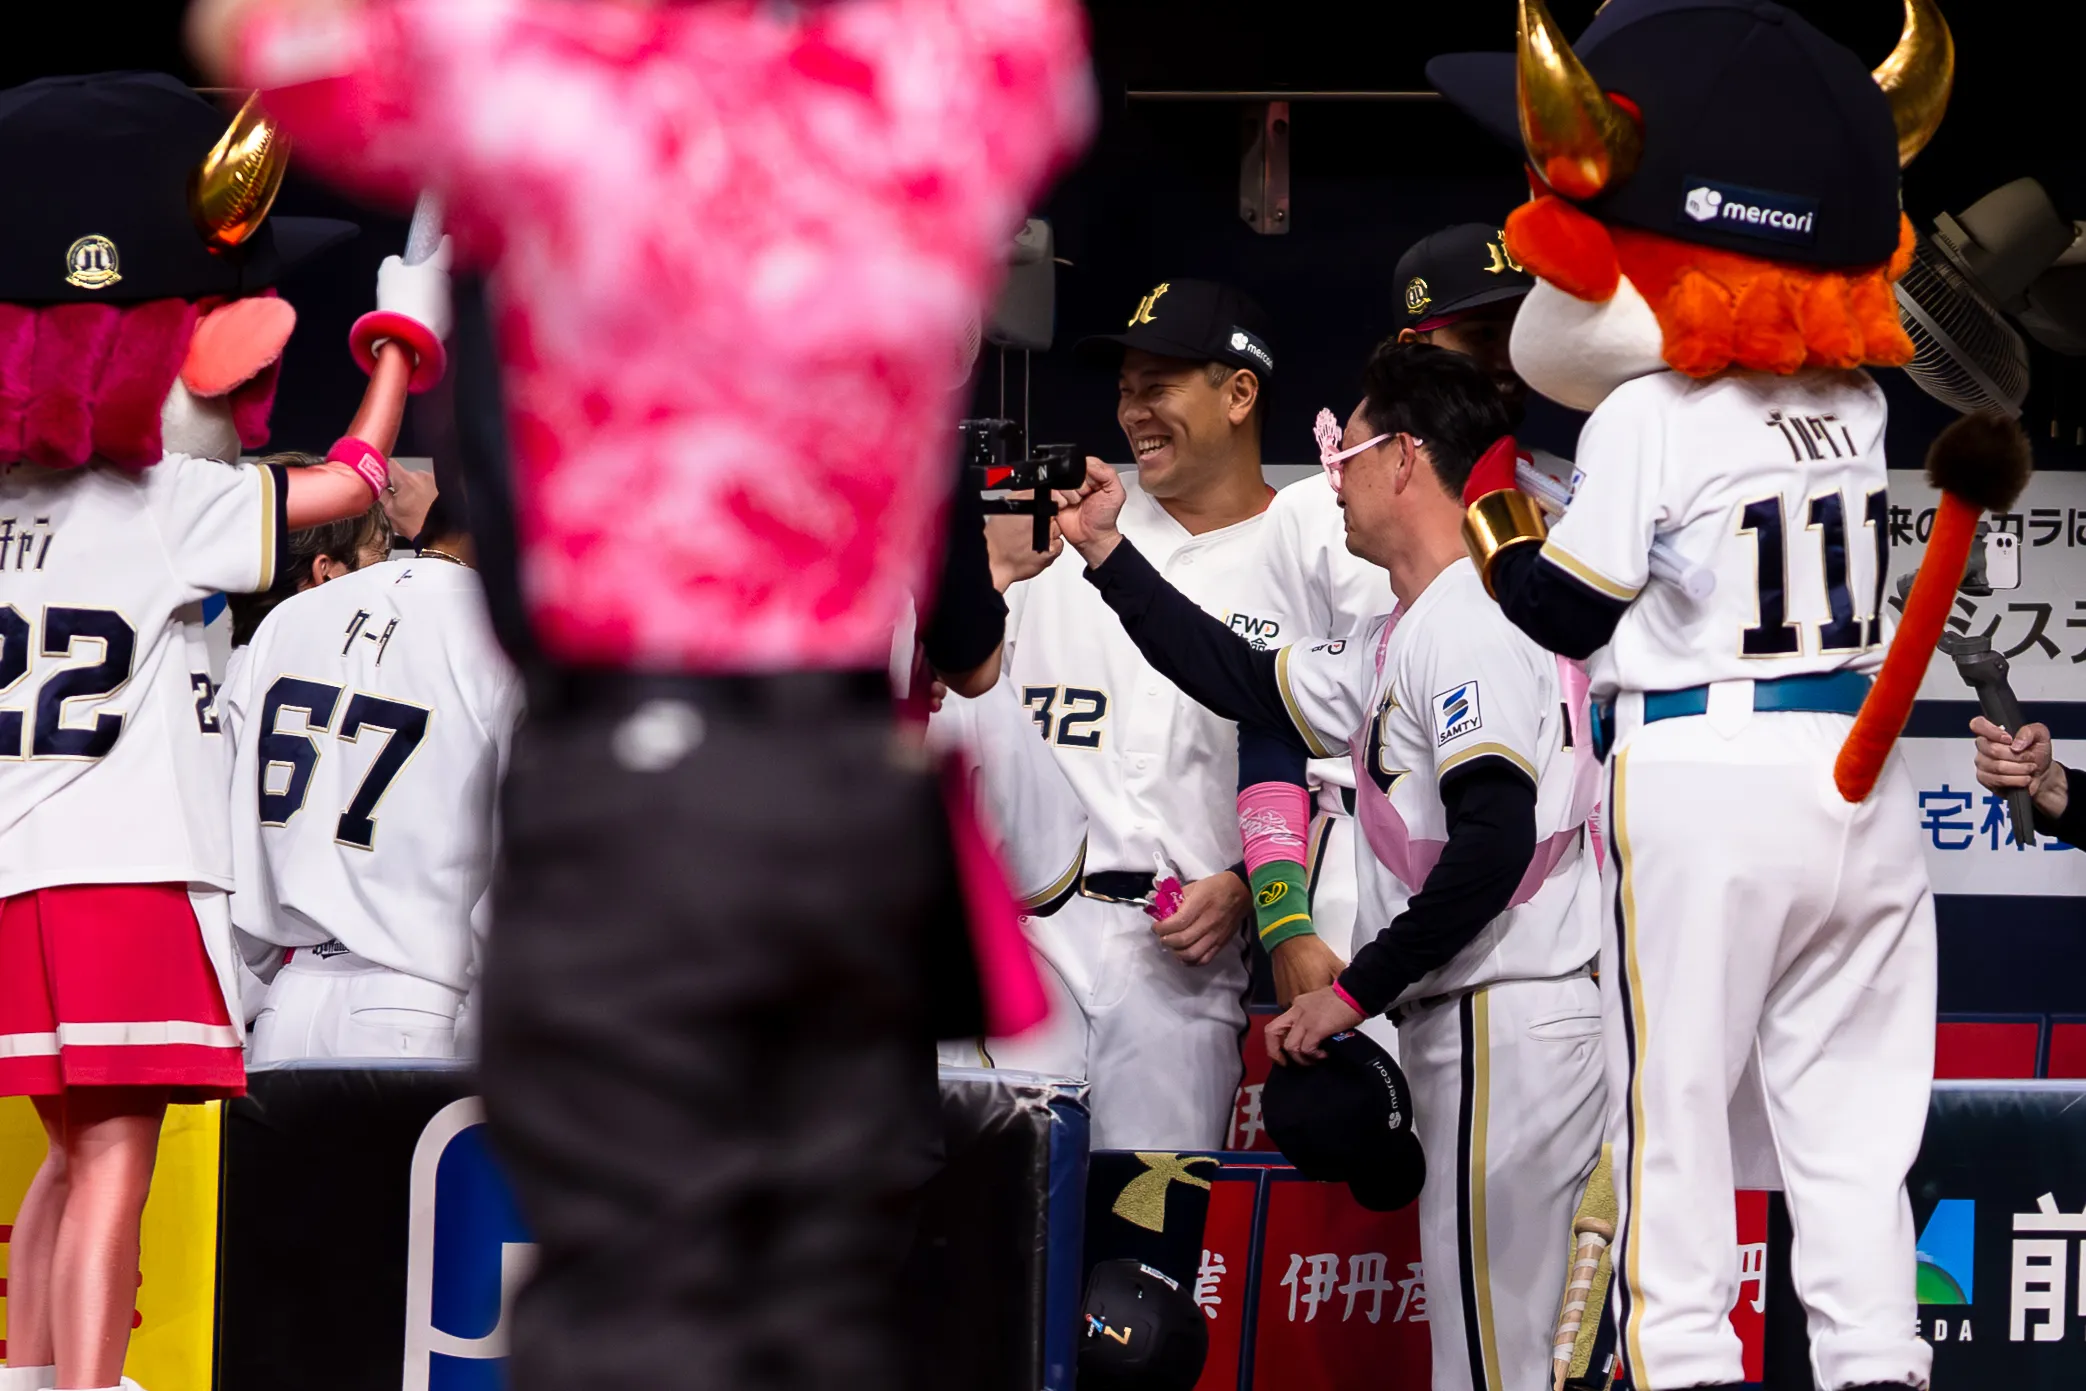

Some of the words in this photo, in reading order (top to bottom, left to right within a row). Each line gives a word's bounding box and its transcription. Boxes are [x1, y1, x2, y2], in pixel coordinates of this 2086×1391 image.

[1722, 201, 1813, 232] mercari
[1734, 485, 1890, 660] 111
[1230, 613, 1280, 639] FWD
[1022, 684, 1110, 752] 32
[1439, 717, 1479, 743] SAMTY
[257, 672, 434, 852] 67
[1372, 1061, 1399, 1109] mercari
